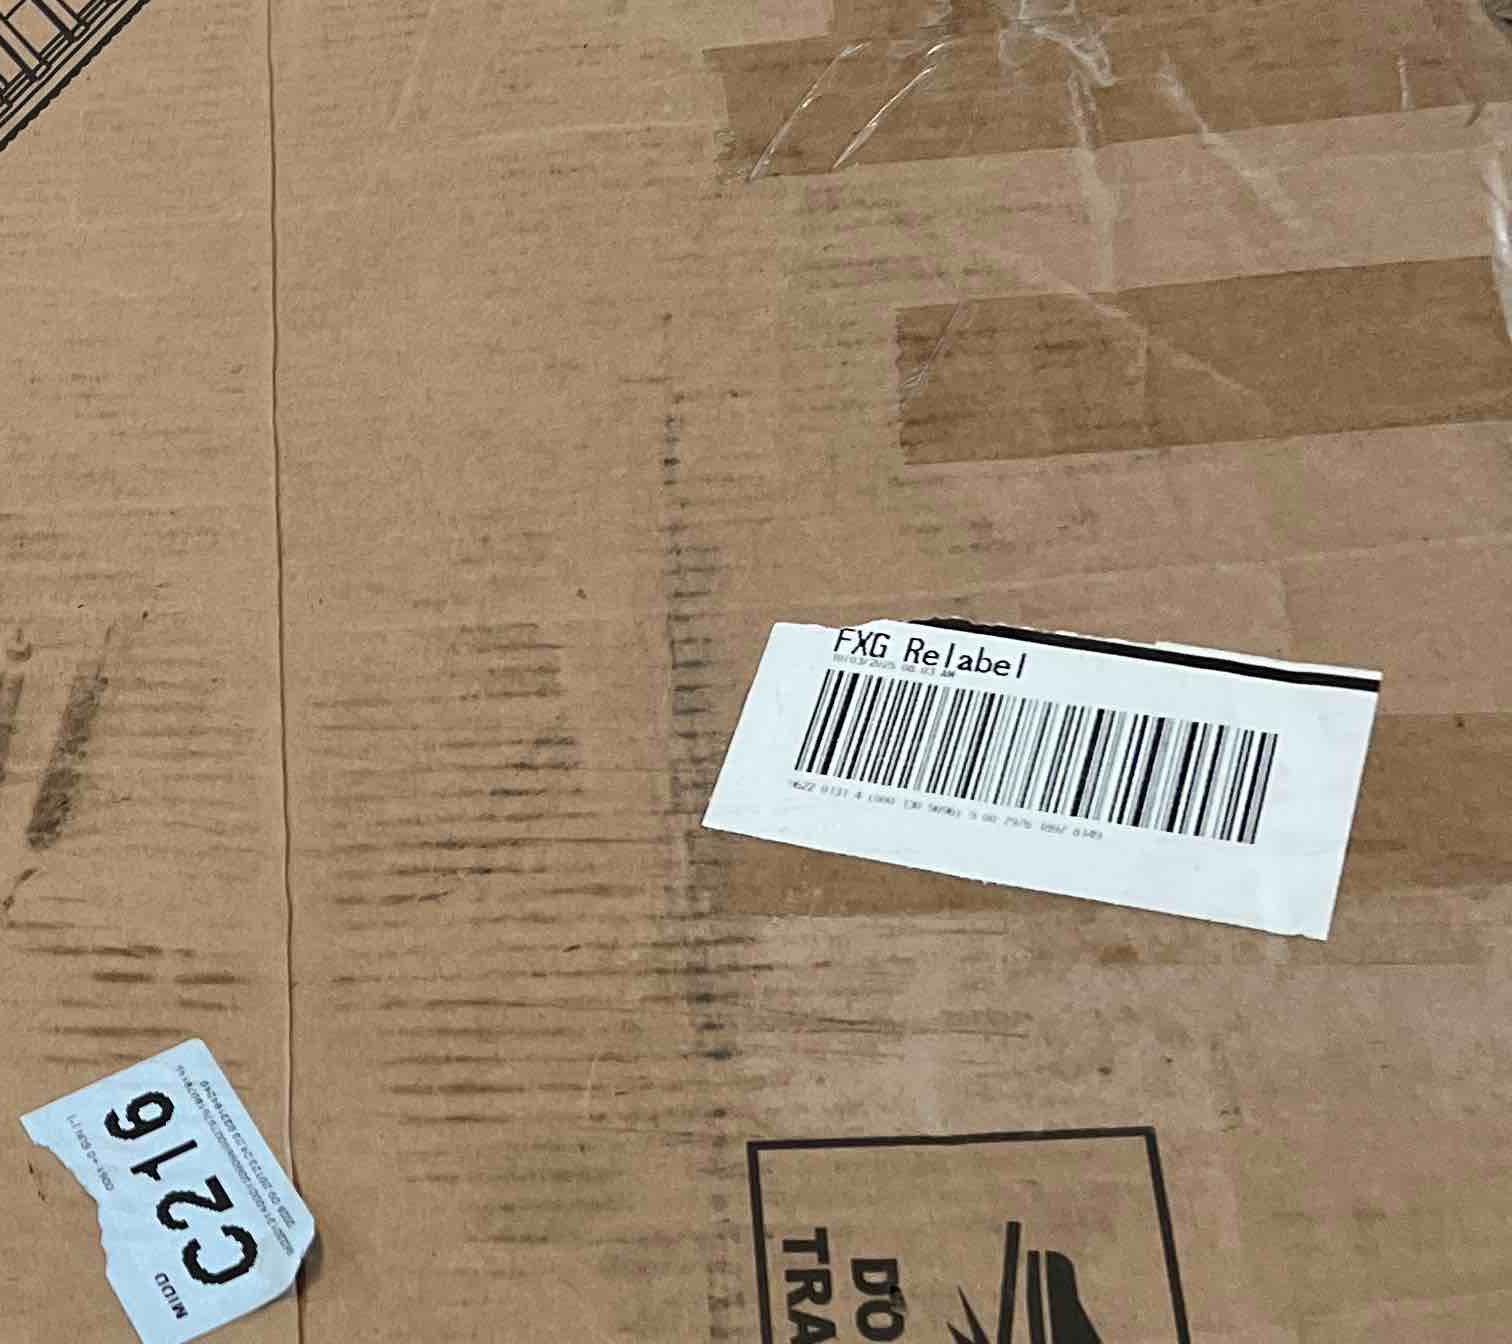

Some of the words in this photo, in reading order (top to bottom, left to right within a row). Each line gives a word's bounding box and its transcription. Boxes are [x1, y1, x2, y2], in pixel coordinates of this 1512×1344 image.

[833, 628, 891, 659] FXG
[902, 636, 1028, 679] Relabel
[104, 1091, 258, 1285] C216
[154, 1272, 188, 1319] MIDD
[850, 1258, 905, 1343] DO
